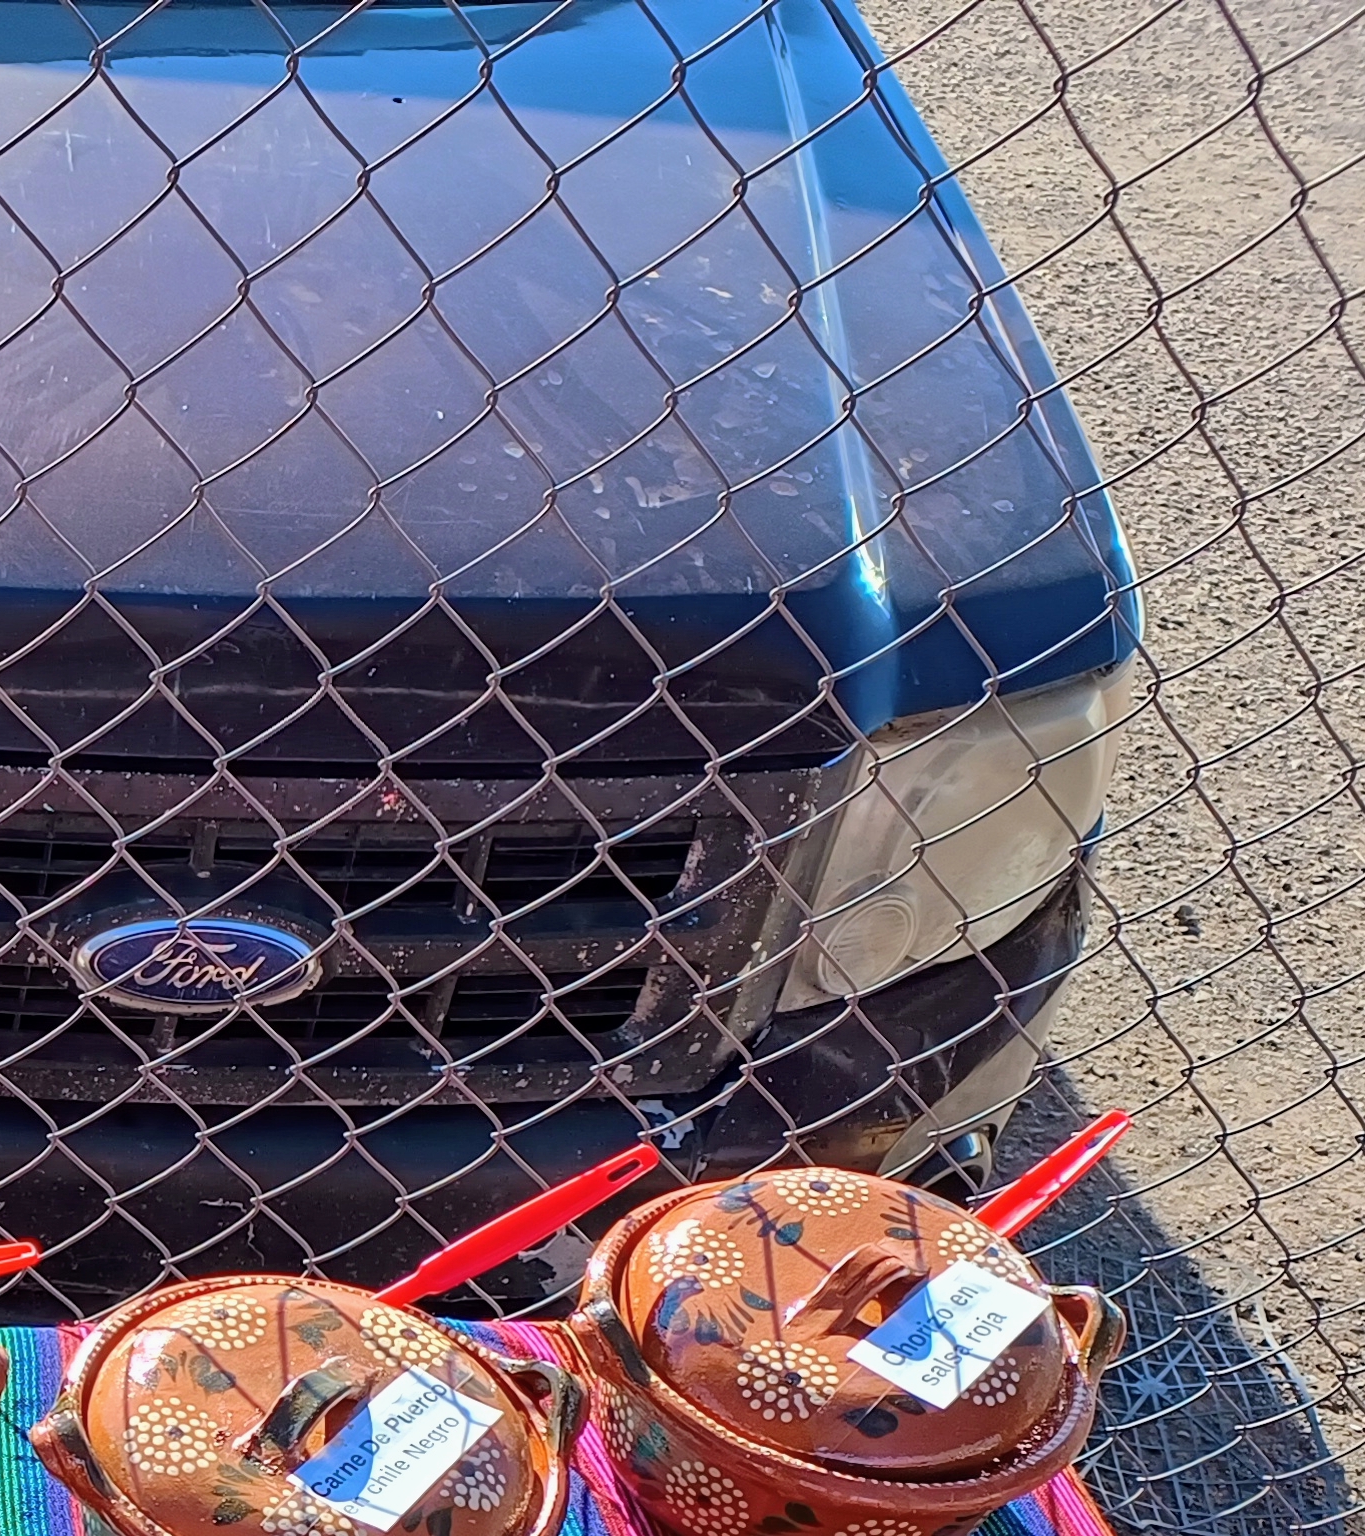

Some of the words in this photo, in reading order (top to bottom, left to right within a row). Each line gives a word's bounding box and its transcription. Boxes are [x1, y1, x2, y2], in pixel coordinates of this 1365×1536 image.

[134, 937, 265, 989] Ford
[881, 1307, 954, 1367] Chorizo
[950, 1284, 979, 1307] en
[921, 1342, 973, 1386] salsa
[965, 1310, 1007, 1344] roja
[311, 1453, 367, 1498] Carne
[363, 1433, 391, 1457] De
[384, 1384, 448, 1434] Puerco
[343, 1497, 370, 1515] en
[367, 1458, 410, 1495] chile
[403, 1416, 460, 1460] Negro
